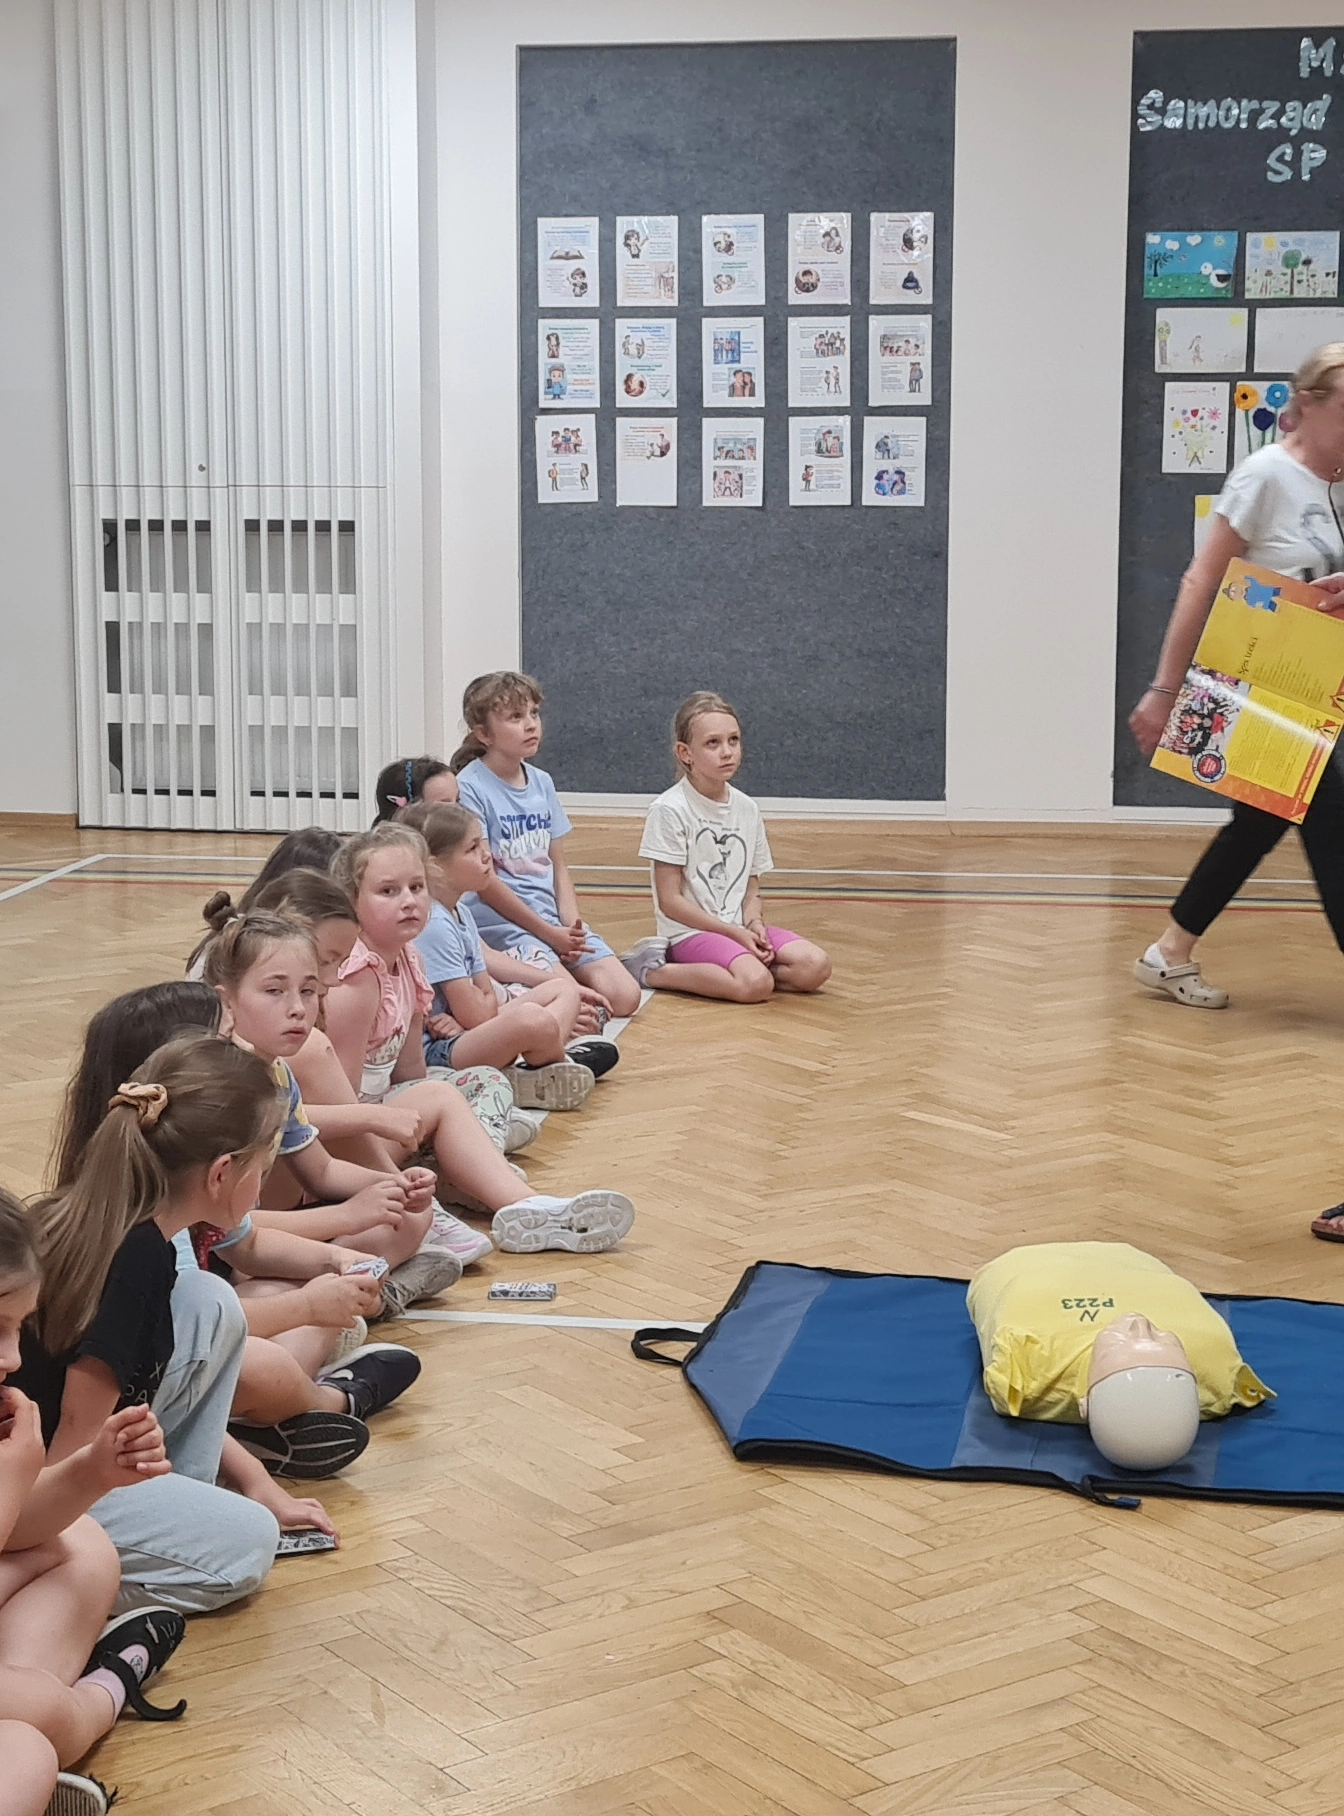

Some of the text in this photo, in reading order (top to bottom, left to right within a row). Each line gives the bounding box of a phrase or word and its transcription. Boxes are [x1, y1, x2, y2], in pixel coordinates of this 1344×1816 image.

[1136, 89, 1332, 136] Samorząd
[1266, 142, 1327, 183] SP
[1061, 1297, 1115, 1310] P223
